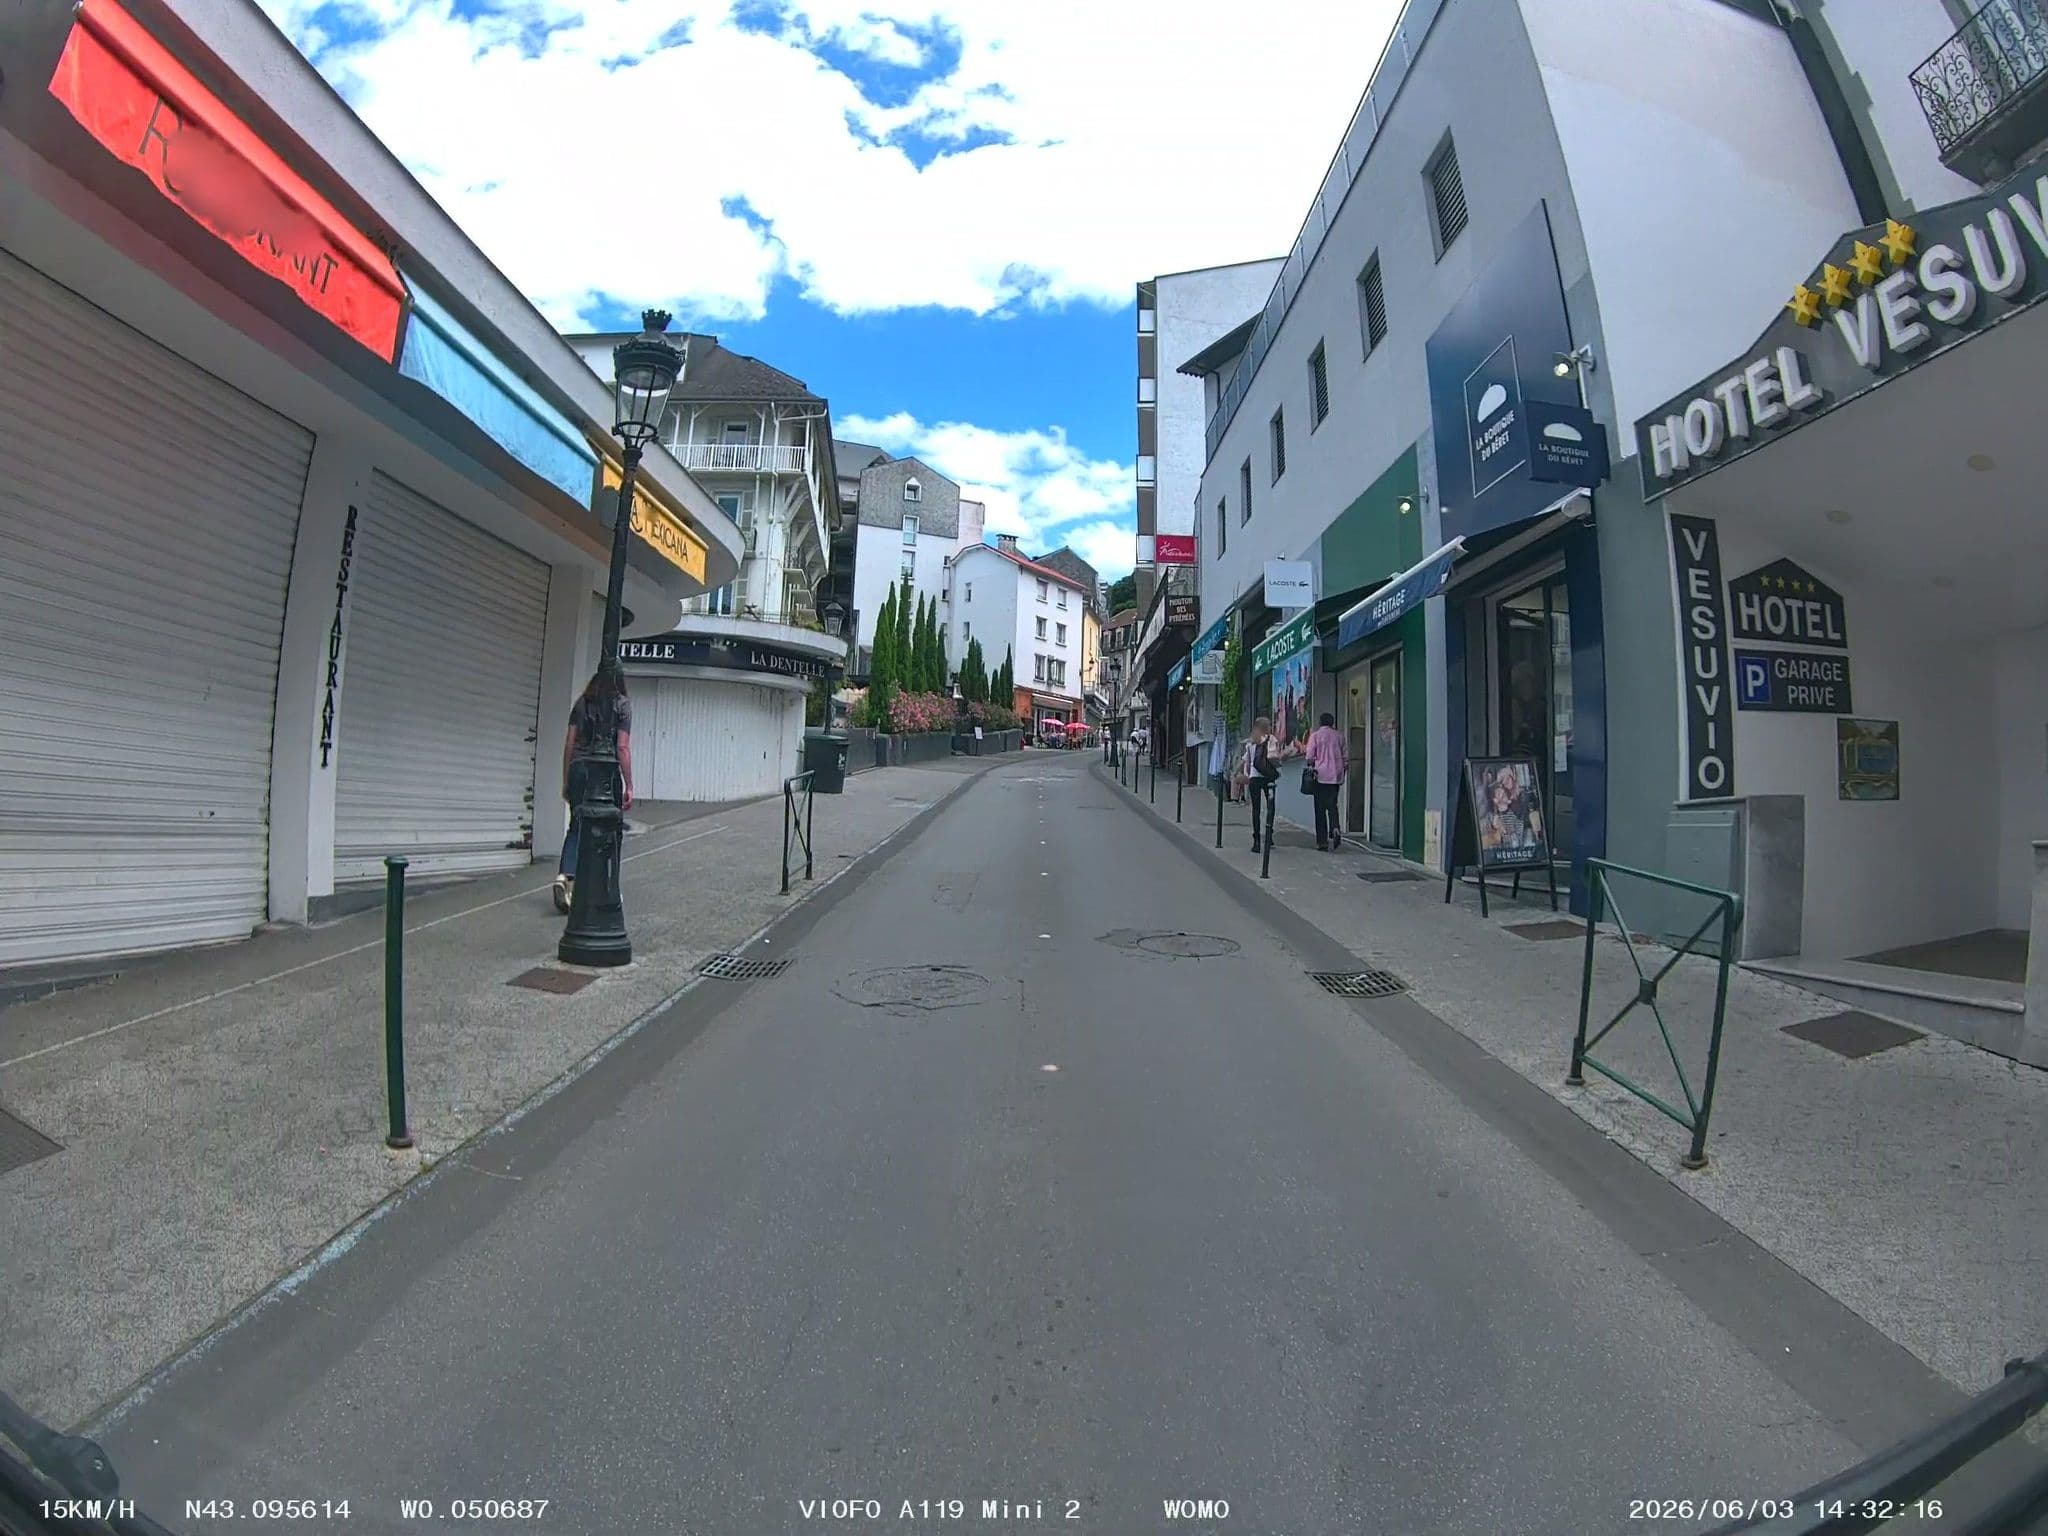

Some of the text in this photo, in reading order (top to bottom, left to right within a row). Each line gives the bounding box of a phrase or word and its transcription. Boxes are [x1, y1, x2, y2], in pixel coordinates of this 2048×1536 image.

[1649, 174, 2048, 479] HOTEL VESUV
[1475, 409, 1515, 451] LA BOUTIQUE
[1481, 448, 1492, 461] DU
[1538, 443, 1590, 458] LA BOUTIQUE
[1547, 453, 1560, 462] DU
[1268, 580, 1297, 588] LACOSTE
[1176, 605, 1188, 614] DES
[1372, 588, 1407, 621] HÉRITAGE
[1738, 591, 1842, 641] HOTEL
[319, 504, 359, 768] RESTAURANT
[619, 642, 675, 659] TELLE
[1266, 629, 1296, 665] LACOSTE
[751, 651, 825, 678] LA DENTELLE
[1681, 527, 1726, 790] VESUVIO
[1775, 657, 1843, 682] GARAGE
[1745, 663, 1765, 698] P
